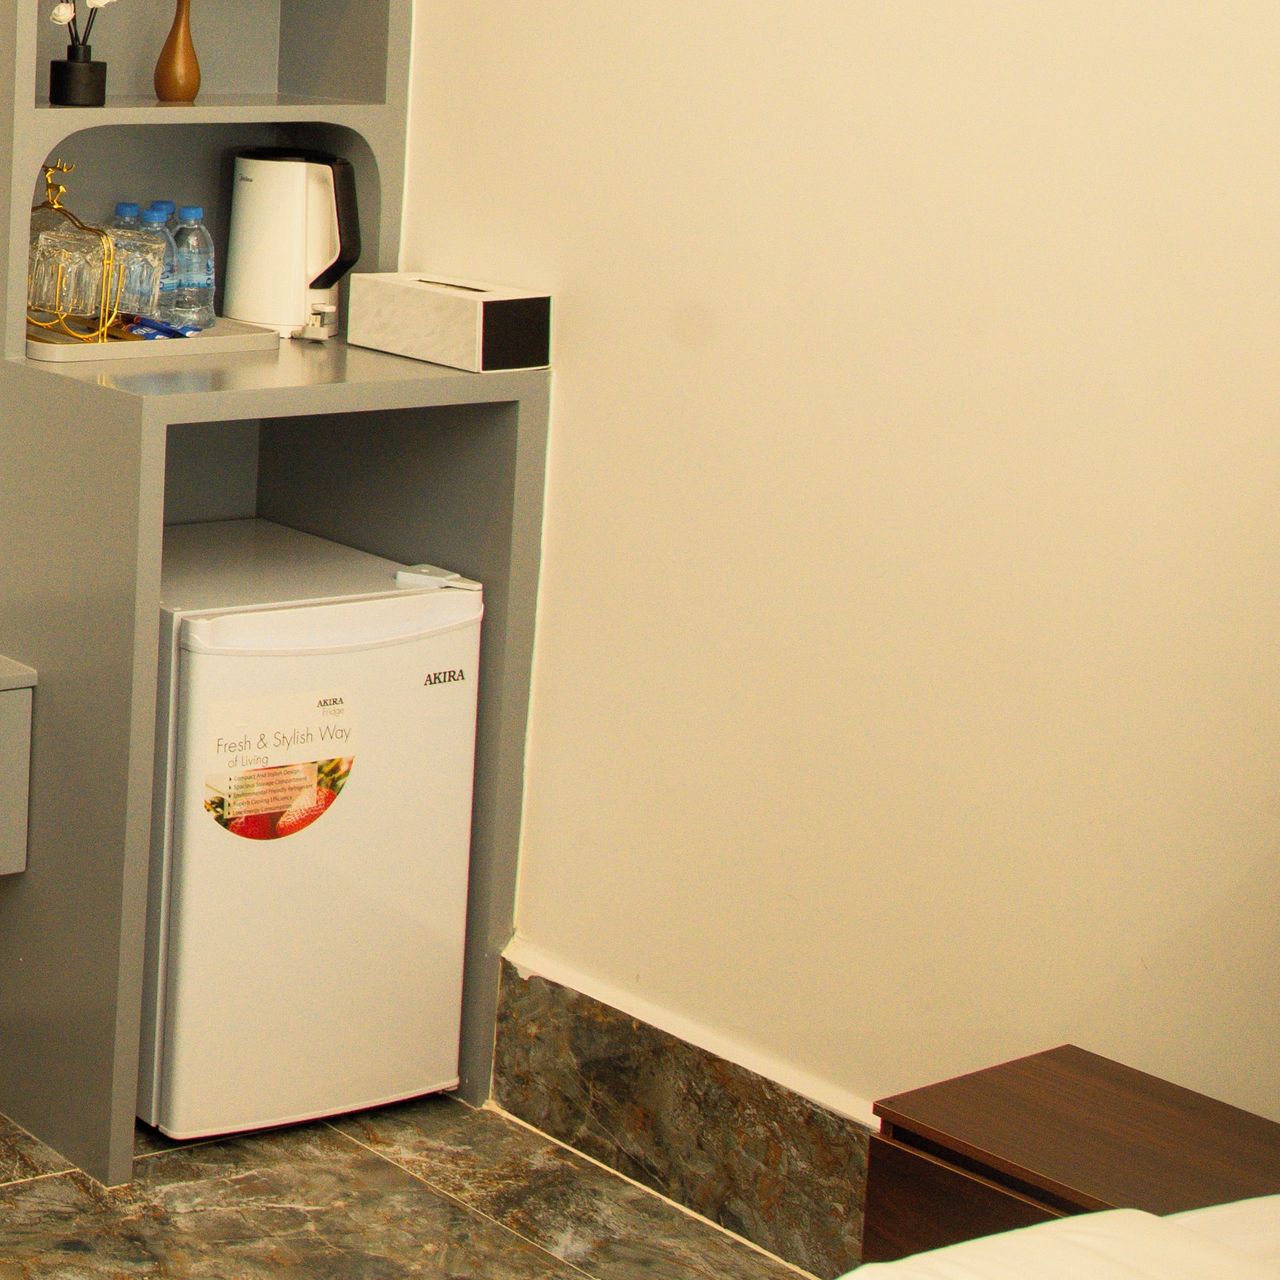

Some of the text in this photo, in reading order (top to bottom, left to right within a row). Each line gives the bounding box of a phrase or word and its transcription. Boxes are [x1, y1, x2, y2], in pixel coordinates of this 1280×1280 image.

[423, 669, 466, 686] AKIRA
[317, 697, 344, 708] AKIRA
[321, 706, 345, 717] Fridge
[216, 724, 352, 755] Fresh & Stylish Way
[227, 754, 269, 768] of Living
